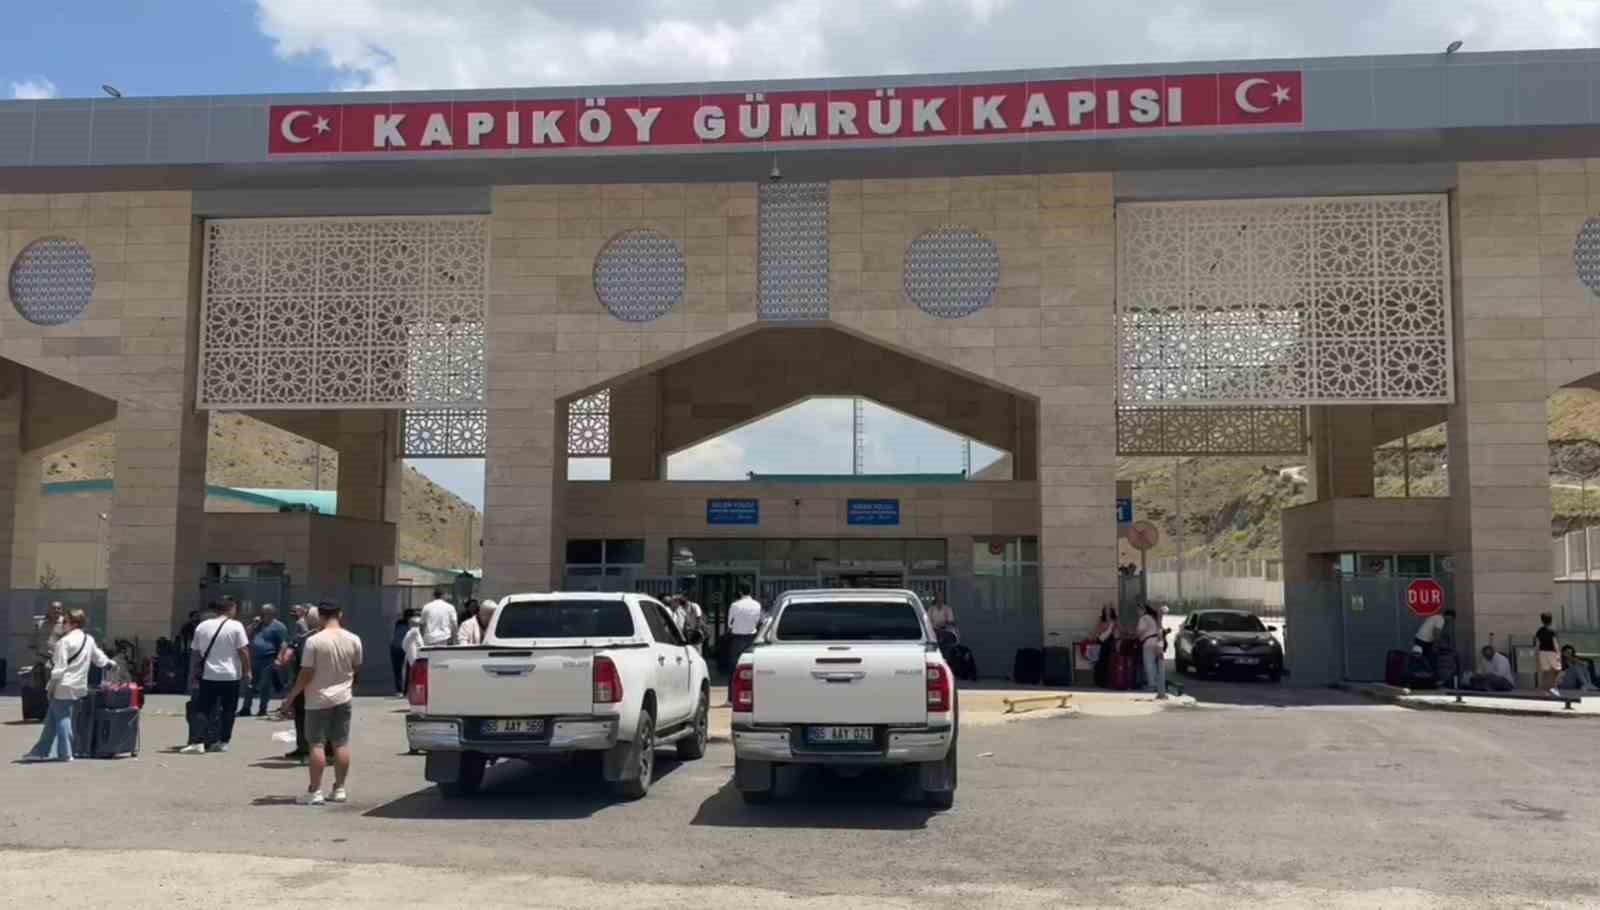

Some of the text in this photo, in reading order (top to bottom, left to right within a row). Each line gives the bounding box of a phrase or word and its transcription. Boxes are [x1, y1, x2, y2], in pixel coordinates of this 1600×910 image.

[373, 86, 1183, 148] KAPIKÖY GÜMRÜK KAPISI
[1408, 589, 1440, 604] DUR
[832, 727, 849, 738] AAY
